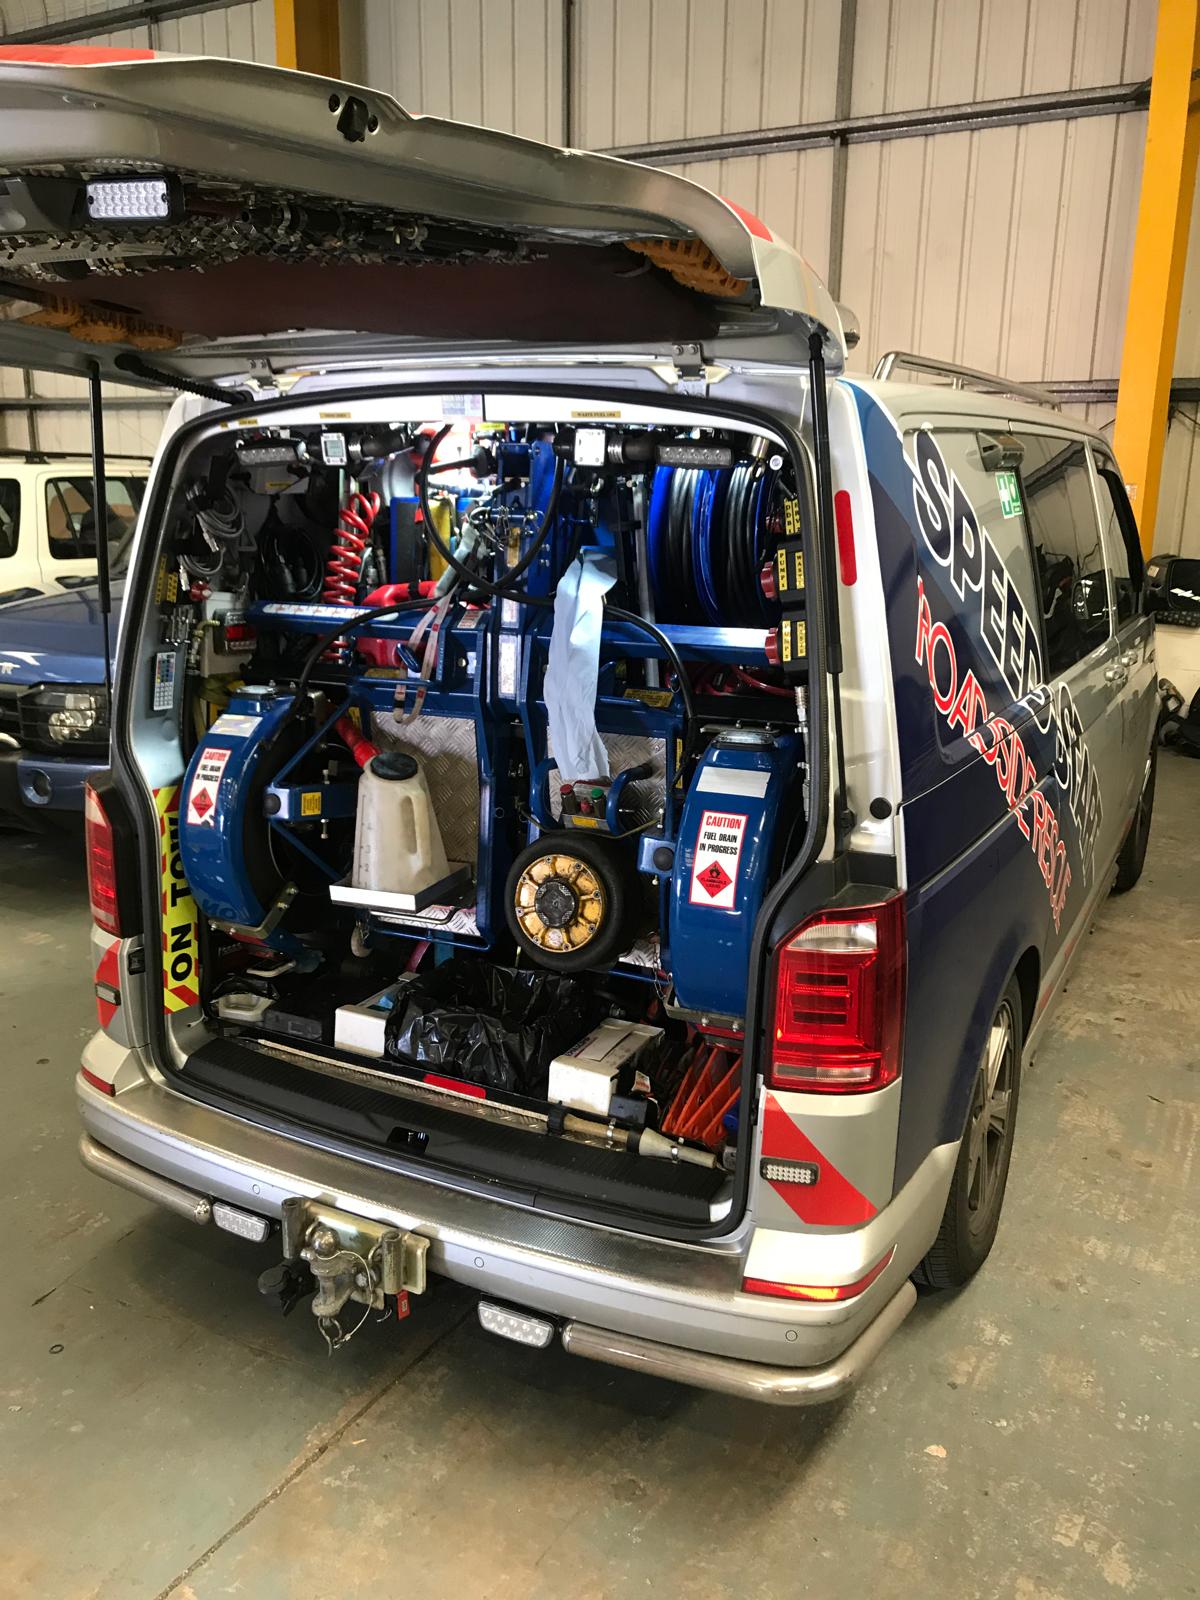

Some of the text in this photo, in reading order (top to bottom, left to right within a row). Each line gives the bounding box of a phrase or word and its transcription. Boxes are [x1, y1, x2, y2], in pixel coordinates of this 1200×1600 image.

[913, 428, 1055, 735] SPEED
[914, 574, 1038, 842] ROADSIDE
[703, 831, 738, 843] FUEL DRAIN
[705, 815, 742, 829] CAUTION
[699, 843, 738, 855] IN PROGRESS
[170, 922, 192, 982] ON
